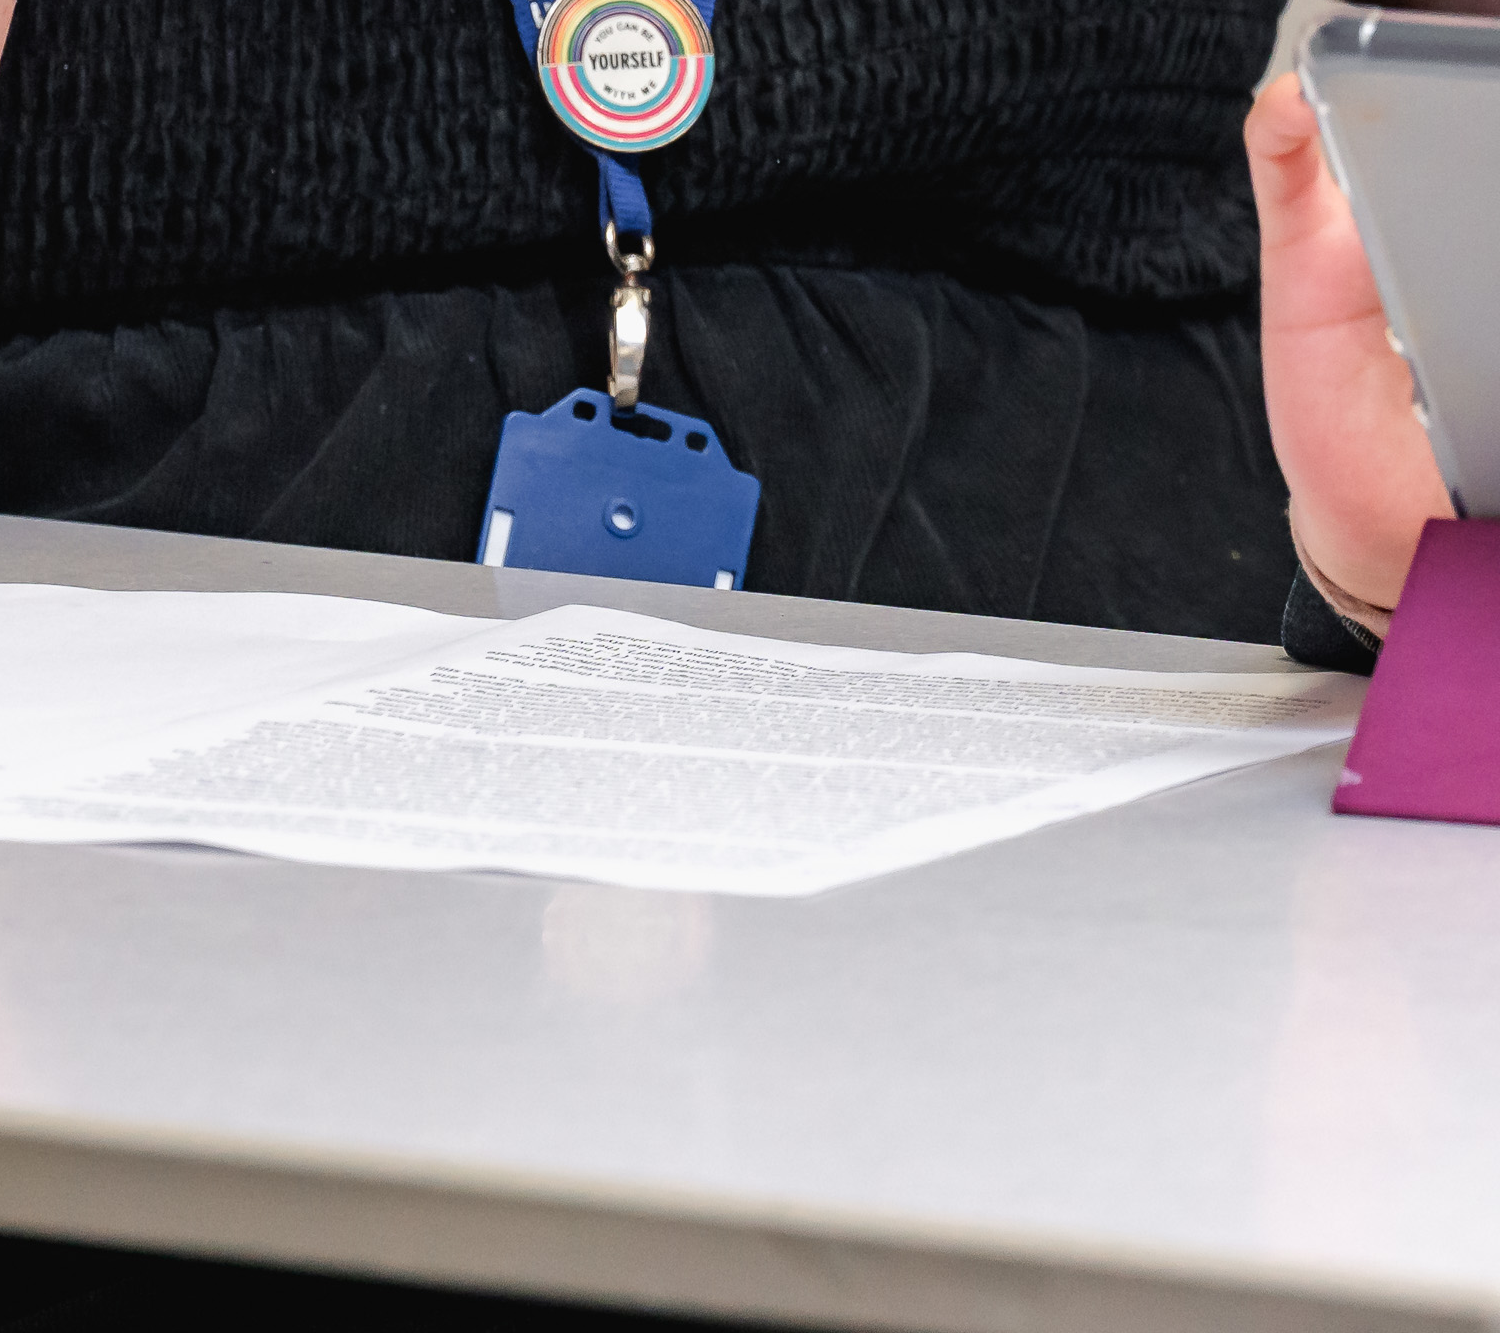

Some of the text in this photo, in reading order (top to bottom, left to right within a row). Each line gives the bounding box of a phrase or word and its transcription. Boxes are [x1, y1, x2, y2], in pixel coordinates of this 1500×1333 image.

[595, 20, 656, 44] YOU CAN BE
[588, 50, 666, 71] YOURSELF
[603, 79, 658, 100] WITH ME
